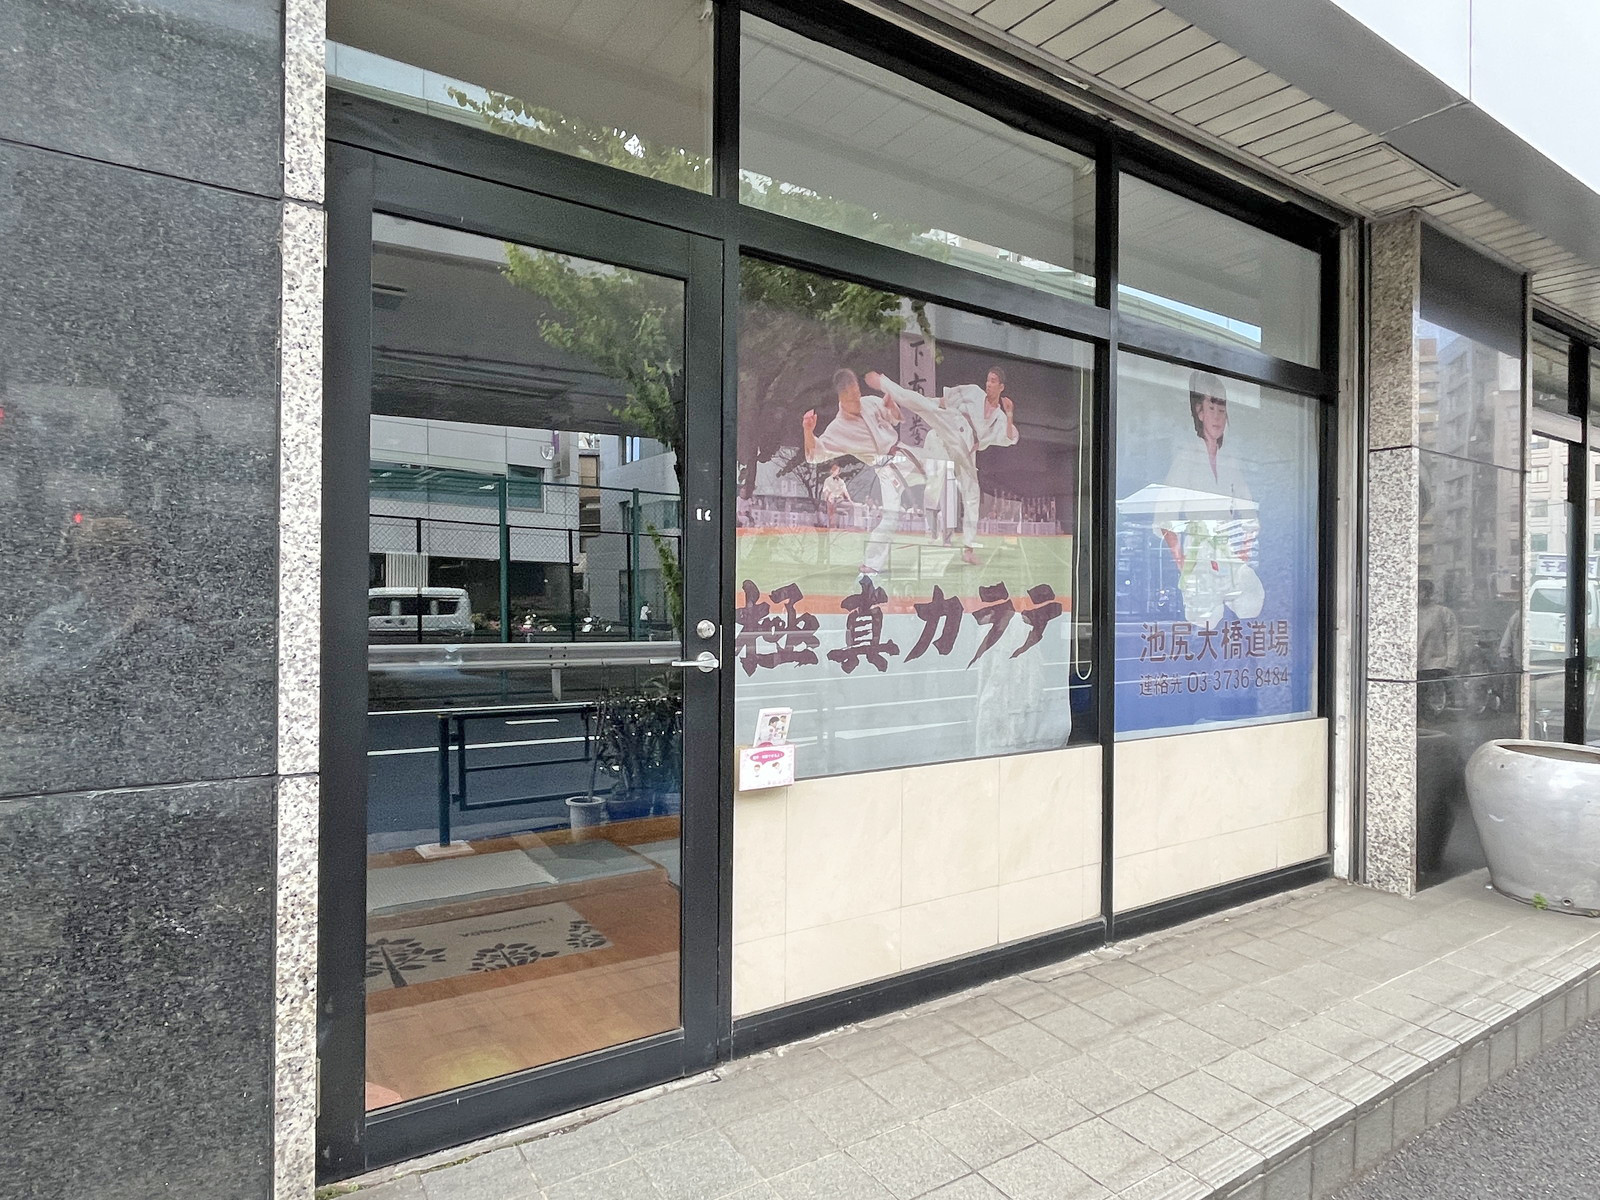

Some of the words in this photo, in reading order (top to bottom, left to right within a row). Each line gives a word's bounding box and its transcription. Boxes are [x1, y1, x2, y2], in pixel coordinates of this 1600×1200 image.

[735, 575, 1063, 677] 極真カラテ
[1139, 620, 1289, 662] 池尻大橋道場
[1139, 673, 1183, 696] 連絡先
[1213, 668, 1250, 691] 3736
[1255, 666, 1289, 688] 8484
